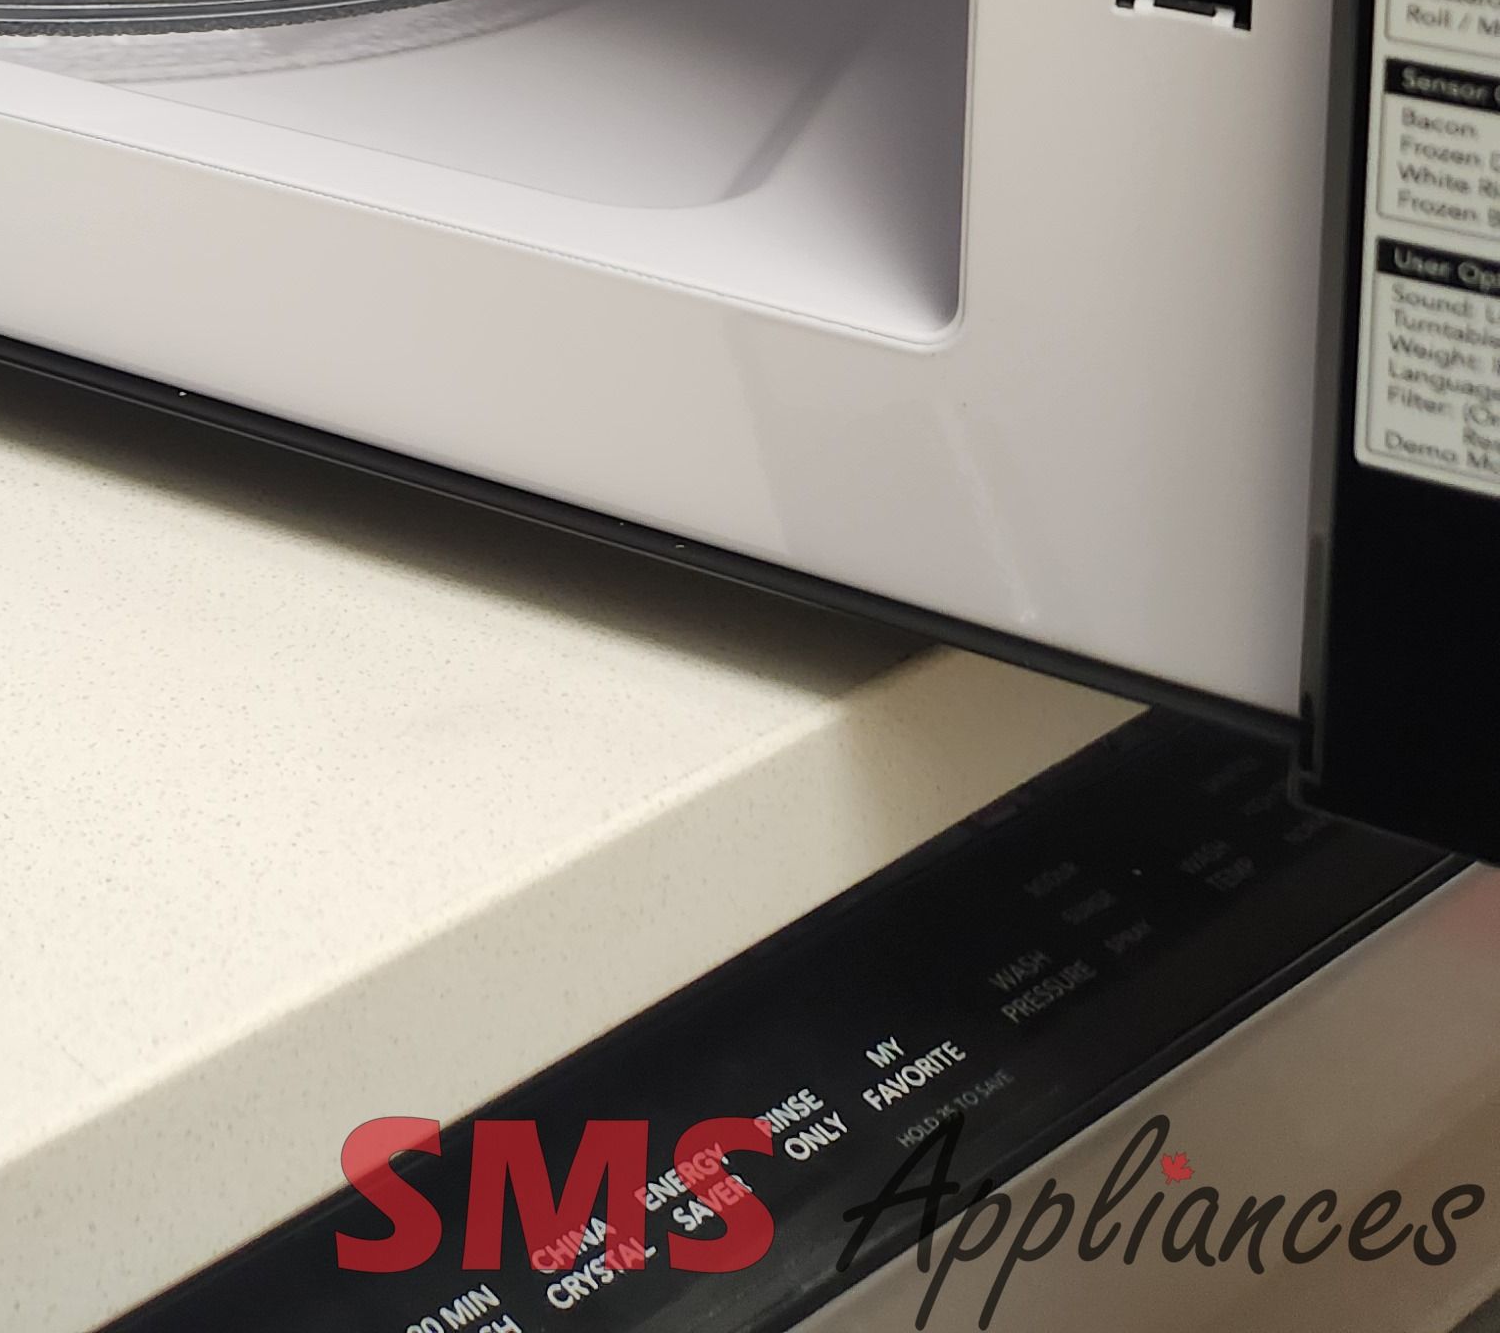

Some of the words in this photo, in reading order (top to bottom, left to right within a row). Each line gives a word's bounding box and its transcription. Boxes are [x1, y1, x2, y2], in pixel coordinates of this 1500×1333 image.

[1406, 3, 1452, 29] Roll
[1402, 64, 1488, 101] Sensor
[1402, 106, 1477, 138] Bacon
[1400, 135, 1481, 166] Frozen
[1398, 160, 1471, 194] White
[1398, 188, 1478, 221] Frozen
[1394, 245, 1450, 277] User
[1385, 429, 1457, 464] Demo
[988, 949, 1054, 993] WASH
[1001, 958, 1099, 1024] PRESSURE
[865, 1036, 905, 1069] MY
[862, 1040, 967, 1112] FAVORITE
[754, 1088, 825, 1138] RINSE
[897, 1116, 941, 1149] HOLD
[784, 1111, 848, 1161] ONLY
[633, 1141, 730, 1213] ENERGY
[672, 1174, 753, 1232] SAVER
[531, 1217, 618, 1275] CHINA
[546, 1236, 657, 1310] CRYSTAL
[439, 1283, 501, 1330] MIN
